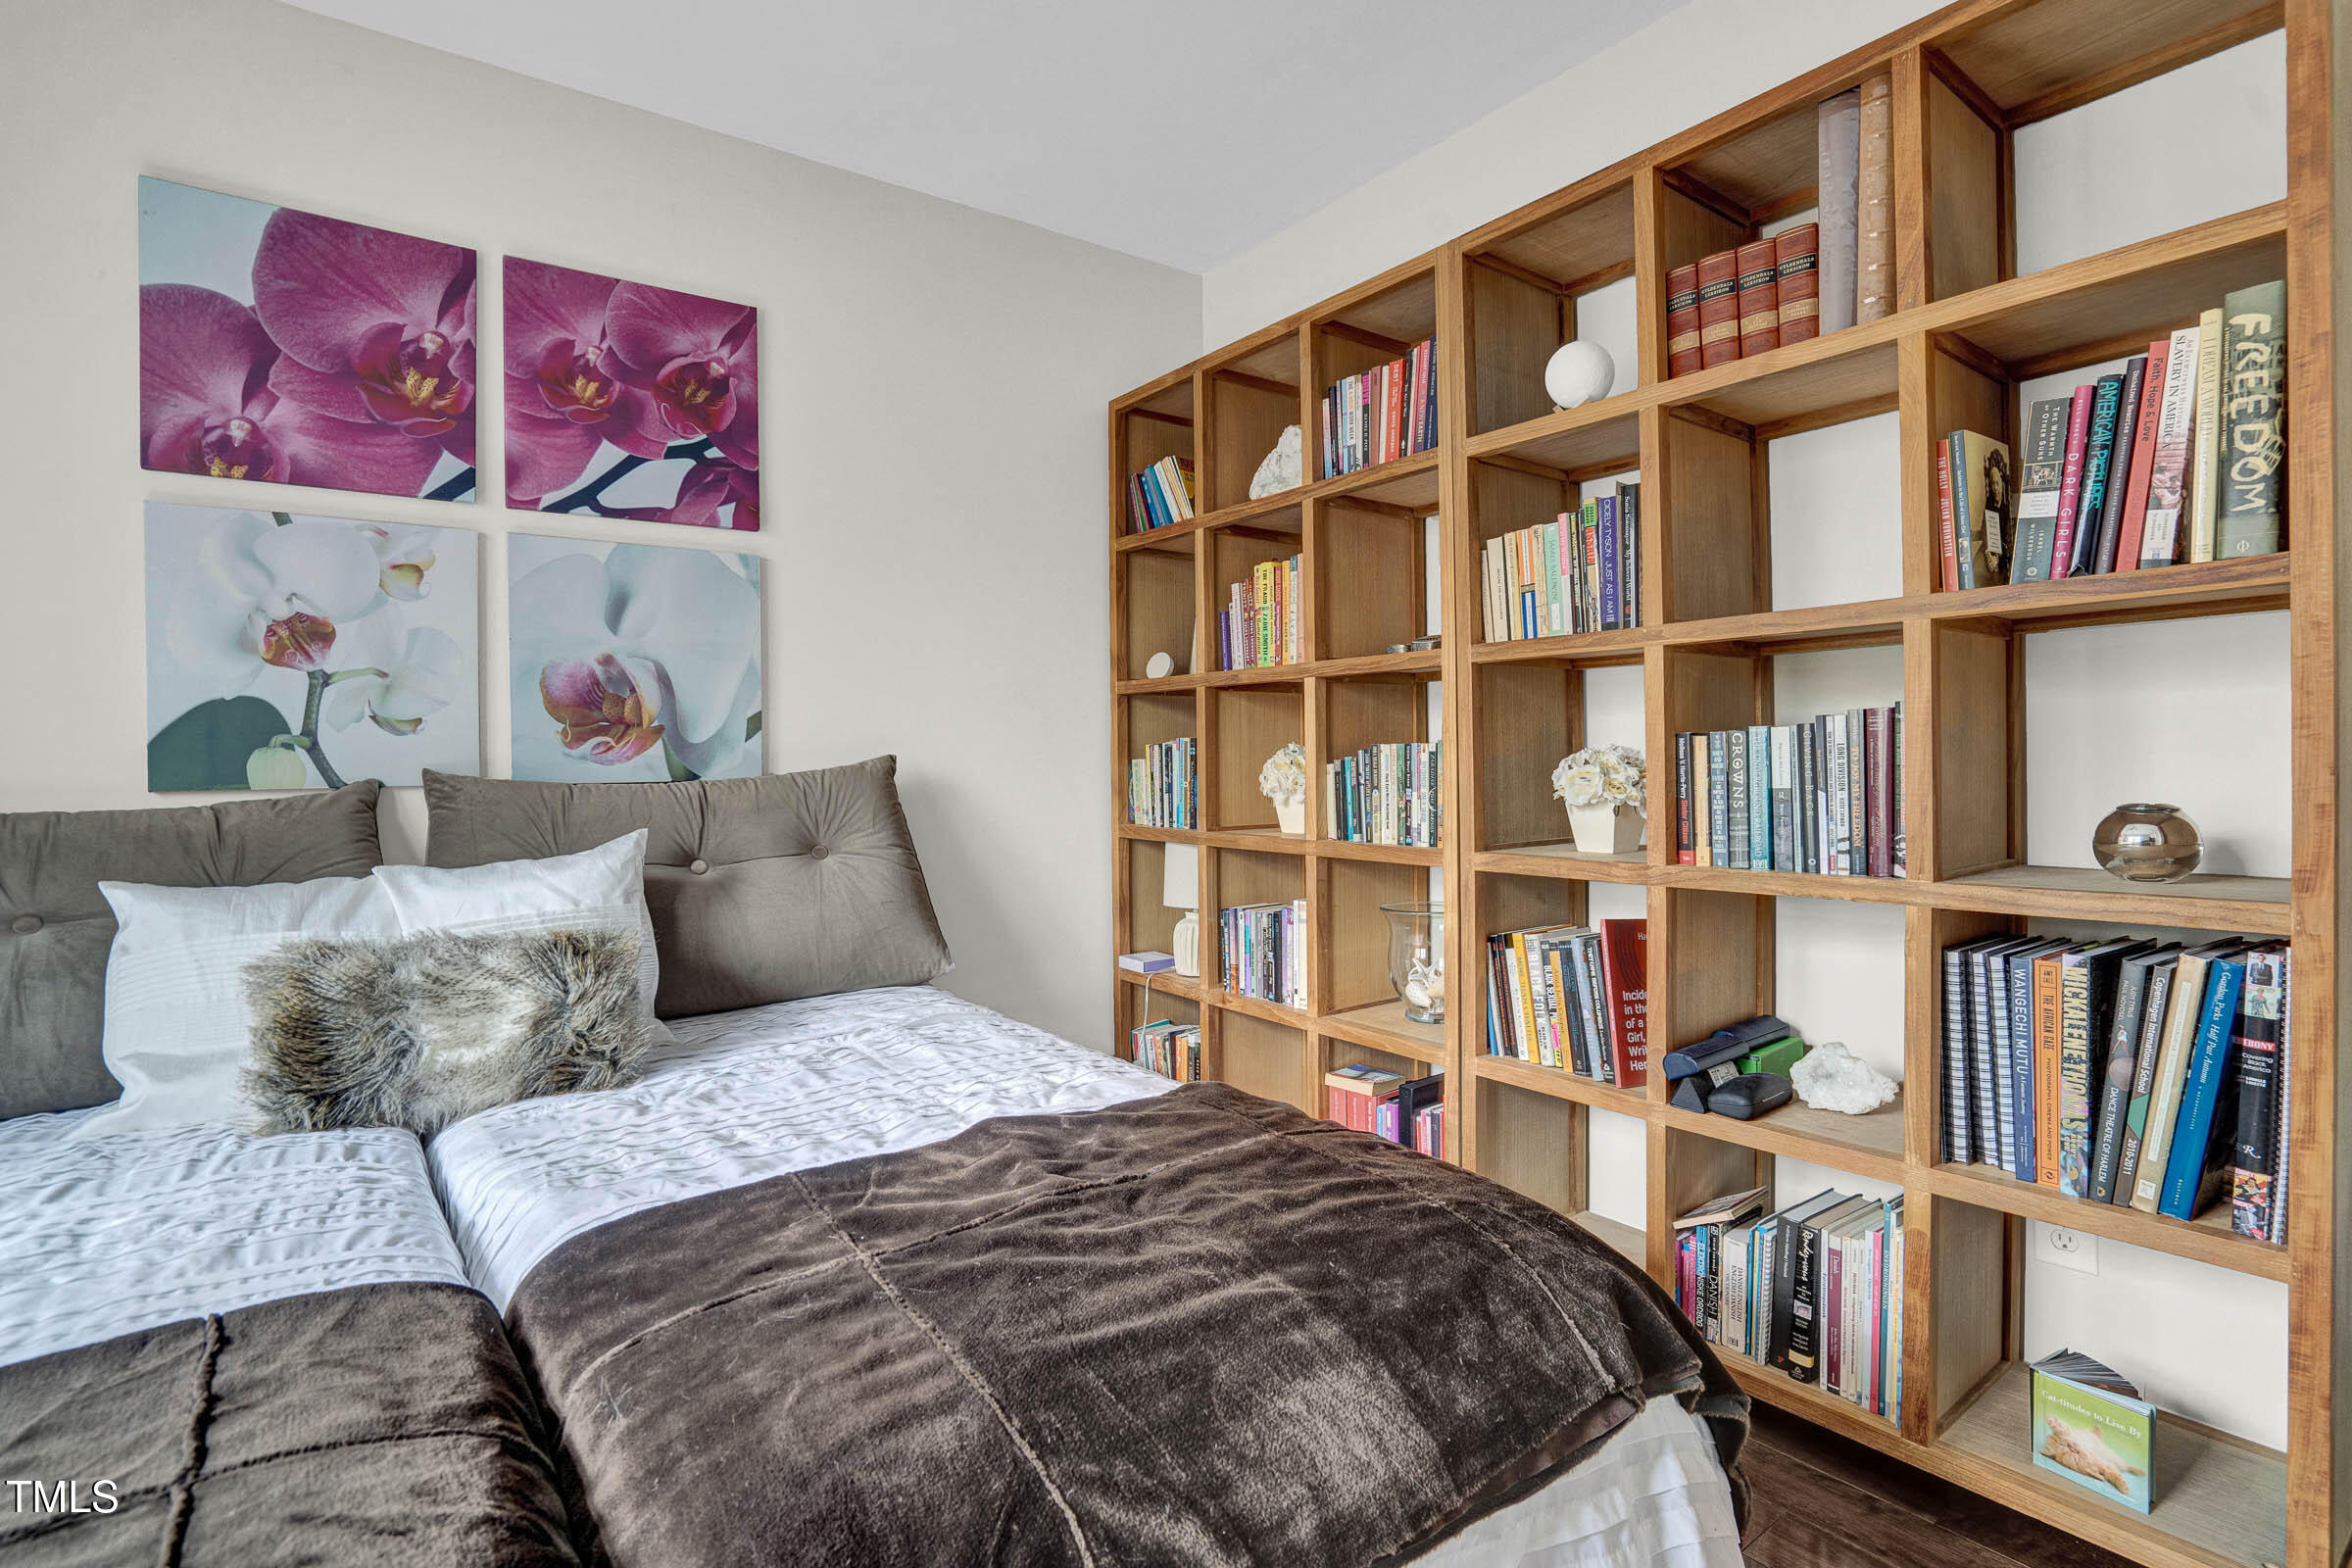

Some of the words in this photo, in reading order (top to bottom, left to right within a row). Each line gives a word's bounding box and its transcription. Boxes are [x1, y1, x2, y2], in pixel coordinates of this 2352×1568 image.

[1780, 257, 1814, 270] GYLDENDALS
[1701, 281, 1734, 294] GYLDENDALS
[1740, 270, 1774, 284] GYLDENDALS
[2150, 358, 2164, 383] Faith,
[2169, 335, 2185, 381] SLAVERY
[2147, 385, 2158, 409] Hope
[2168, 385, 2179, 397] IN
[2039, 413, 2049, 438] OTHER
[2051, 407, 2060, 422] THE
[2091, 381, 2119, 445] AMERICAN
[2161, 400, 2178, 449] AMERICA
[2229, 314, 2272, 512] FREEDOM
[2047, 424, 2057, 457] WARMTH
[2141, 420, 2153, 442] Love
[1937, 457, 1946, 469] THE
[2036, 440, 2046, 461] SUNS
[1939, 470, 1948, 489] HOLLY
[2063, 453, 2079, 497] DARK
[2082, 449, 2109, 510] PICTURES
[1940, 498, 1951, 519] JULIAN
[2055, 508, 2073, 558] GIRLS
[1550, 564, 1559, 603] BALDWIN
[1606, 583, 1613, 594] AS
[1607, 600, 1614, 613] AM
[1803, 731, 1813, 777] GIVING
[1837, 743, 1845, 760] LONG
[1732, 732, 1743, 808] CROWNS
[1838, 762, 1846, 792] DIVISION
[1805, 784, 1814, 816] BACK
[1852, 783, 1860, 798] MY
[1681, 800, 1690, 820] Sister
[1544, 965, 1553, 985] BLACK
[2216, 971, 2231, 1001] Gordon
[1528, 955, 1540, 994] BLACK
[1534, 996, 1545, 1024] FOLK
[1546, 987, 1556, 1010] SEXUAL
[2013, 968, 2028, 1036] WANGECHI
[2042, 994, 2054, 1005] THE
[2148, 977, 2166, 1022] Copenhagen
[1625, 1004, 1633, 1015] in
[2042, 1007, 2055, 1033] AFRICAN
[2062, 965, 2087, 1062] MICKALENE
[2212, 1002, 2226, 1021] Parks
[1626, 1017, 1635, 1029] of
[2207, 1024, 2221, 1041] Half
[1627, 1031, 1646, 1043] Girl,
[2042, 1035, 2055, 1051] GAZE
[2140, 1023, 2158, 1068] International
[2205, 1041, 2217, 1055] Past
[2243, 1039, 2275, 1051] EBONY
[2015, 1038, 2030, 1074] MUTU
[2242, 1053, 2274, 1064] Covering
[2242, 1064, 2272, 1073] America
[2136, 1069, 2150, 1094] School
[2199, 1055, 2214, 1084] Autumn
[2062, 1062, 2087, 1131] THOMAS
[2107, 1087, 2120, 1112] DANCE
[2102, 1113, 2116, 1144] THEATRE
[2101, 1144, 2110, 1153] OF
[2123, 1138, 2137, 1175] 2010-2011
[2097, 1153, 2110, 1183] HARLEM
[1799, 1230, 1814, 1282] Rendez-vous
[1696, 1242, 1705, 1297] ELEKTRONISKE
[1708, 1274, 1718, 1315] DANISH
[2093, 1413, 2103, 1422] to
[2105, 1416, 2127, 1431] Live
[2129, 1426, 2142, 1439] By
